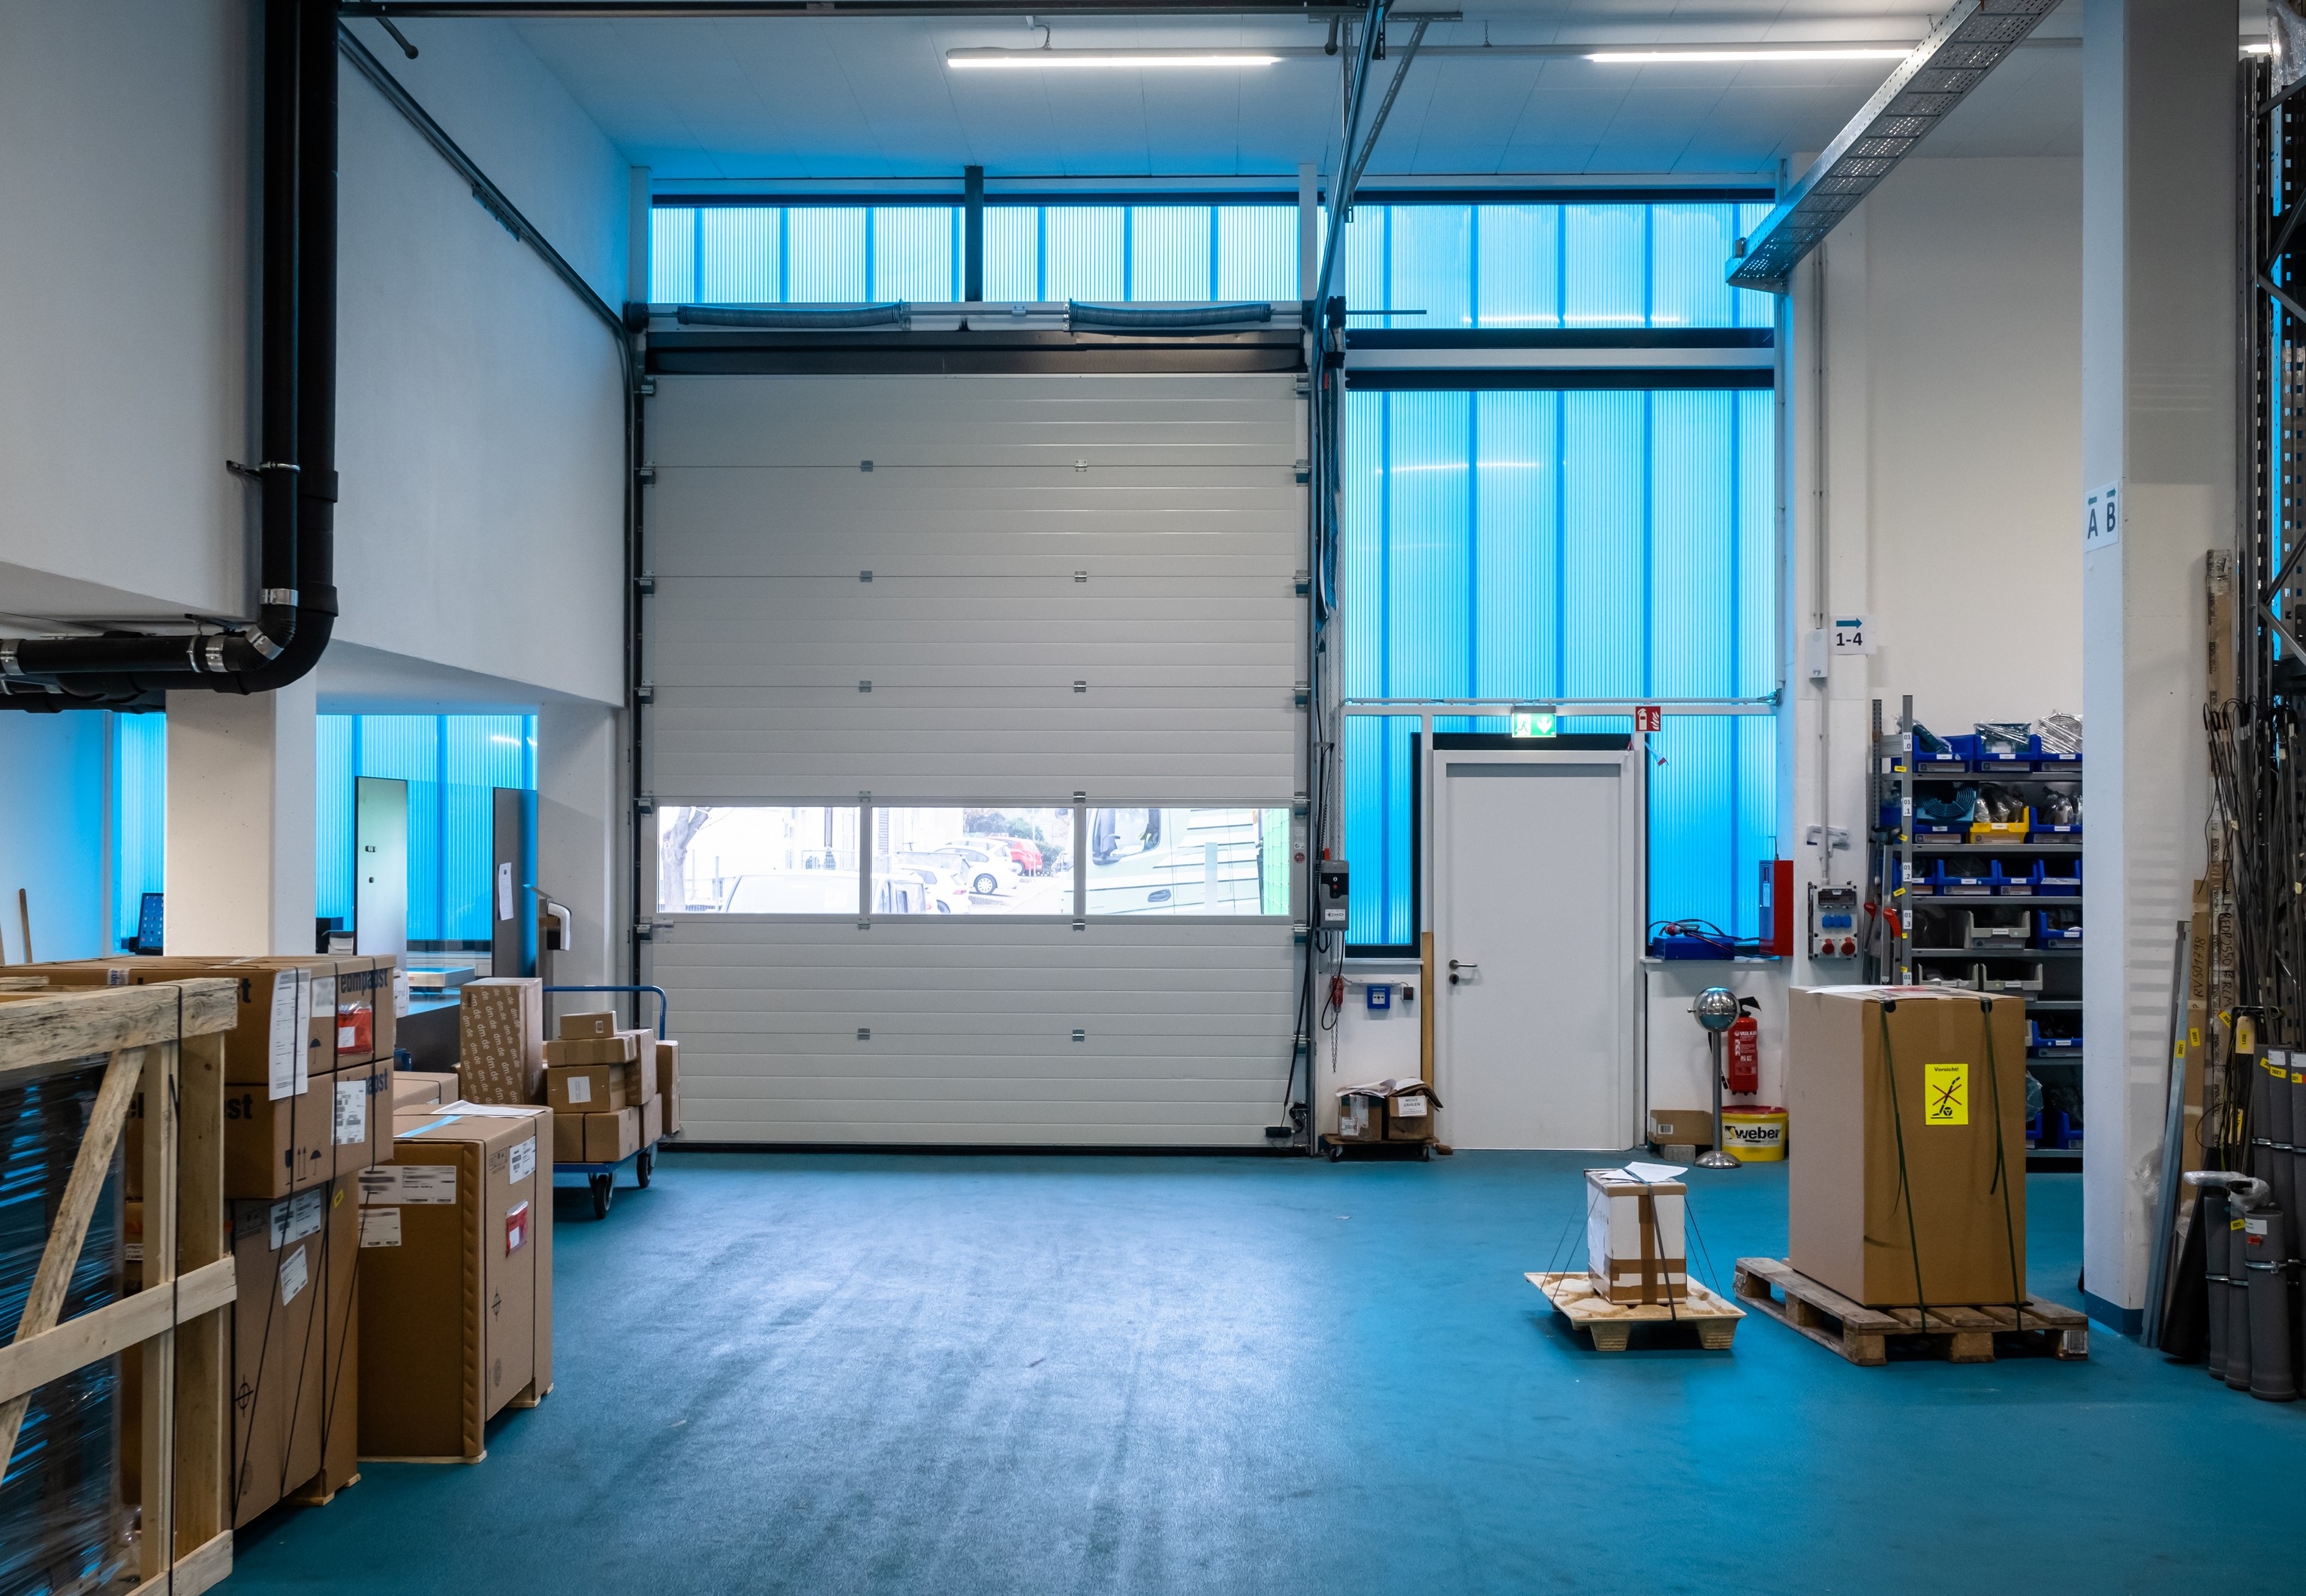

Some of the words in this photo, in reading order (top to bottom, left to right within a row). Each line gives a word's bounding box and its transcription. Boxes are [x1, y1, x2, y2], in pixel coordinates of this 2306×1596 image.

[2088, 508, 2098, 540] A
[2107, 501, 2115, 533] B
[1836, 632, 1862, 646] 1-4
[497, 1001, 506, 1021] dm.de
[503, 1025, 513, 1044] dm.de
[462, 1016, 474, 1038] dm.de
[470, 1042, 481, 1065] dm.de
[477, 1070, 488, 1092] dm.de
[477, 1024, 489, 1050] dm.de
[486, 1055, 498, 1082] dm.de
[485, 1005, 497, 1029] dm.de
[493, 1033, 505, 1057] dm.de
[501, 1061, 513, 1086] dm.de
[464, 1060, 474, 1080] dm.de
[1735, 1126, 1780, 1139] weber
